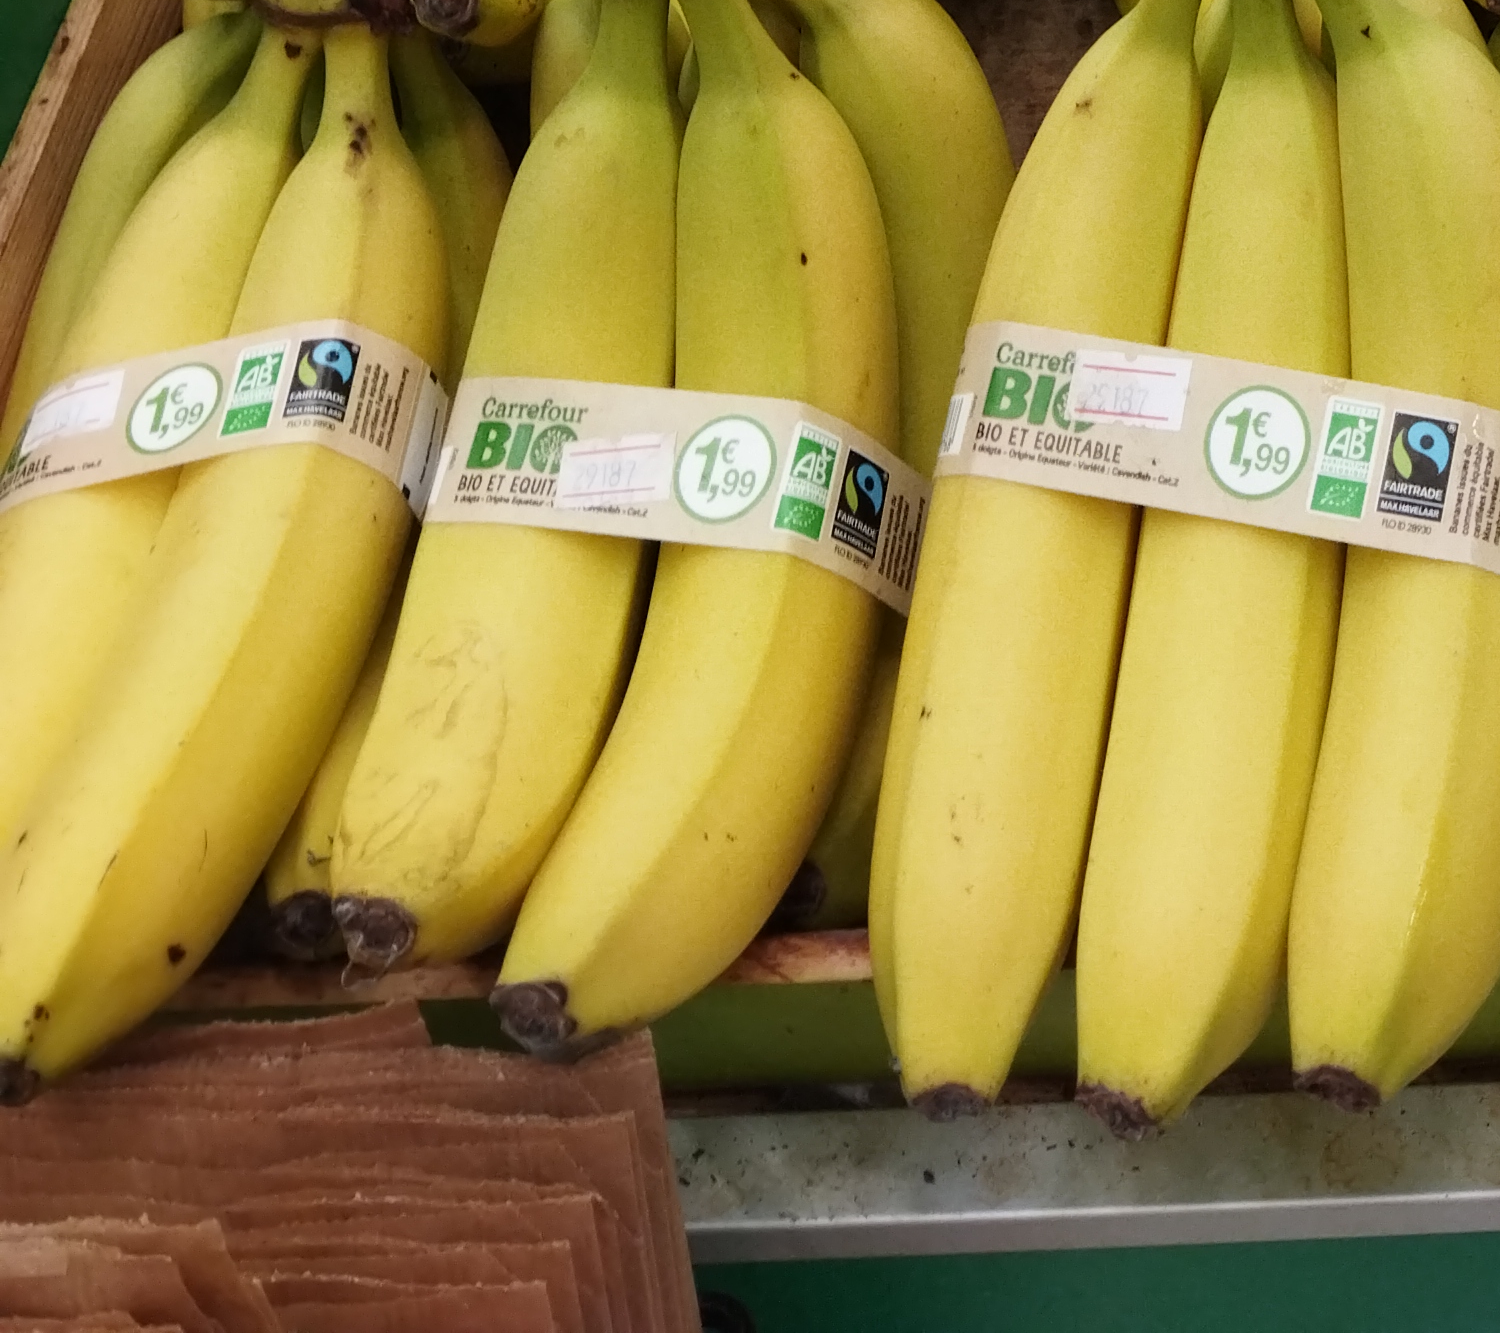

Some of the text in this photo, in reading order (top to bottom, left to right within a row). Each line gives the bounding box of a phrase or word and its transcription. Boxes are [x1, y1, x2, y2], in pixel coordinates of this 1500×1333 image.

[996, 342, 1076, 374] Carref
[237, 364, 273, 393] AB
[289, 390, 347, 405] FAIRTRADE
[482, 396, 589, 424] Carrefour
[466, 421, 578, 475] BIO
[975, 422, 1123, 464] BIO ET EQUITABLE
[1327, 427, 1367, 460] AB
[793, 451, 828, 485] AB
[1009, 449, 1035, 462] Origine
[1037, 453, 1071, 468] Equateur
[1111, 465, 1151, 482] Cavendish
[457, 474, 559, 496] BIO ET EQUIT
[1383, 480, 1444, 501] FAIRTRADE
[836, 509, 880, 541] FAIRTRADE
[1380, 500, 1440, 518] MAX HAVELAAR
[1381, 519, 1397, 530] FLO
[1397, 521, 1406, 531] ID
[1450, 492, 1464, 534] Bananes
